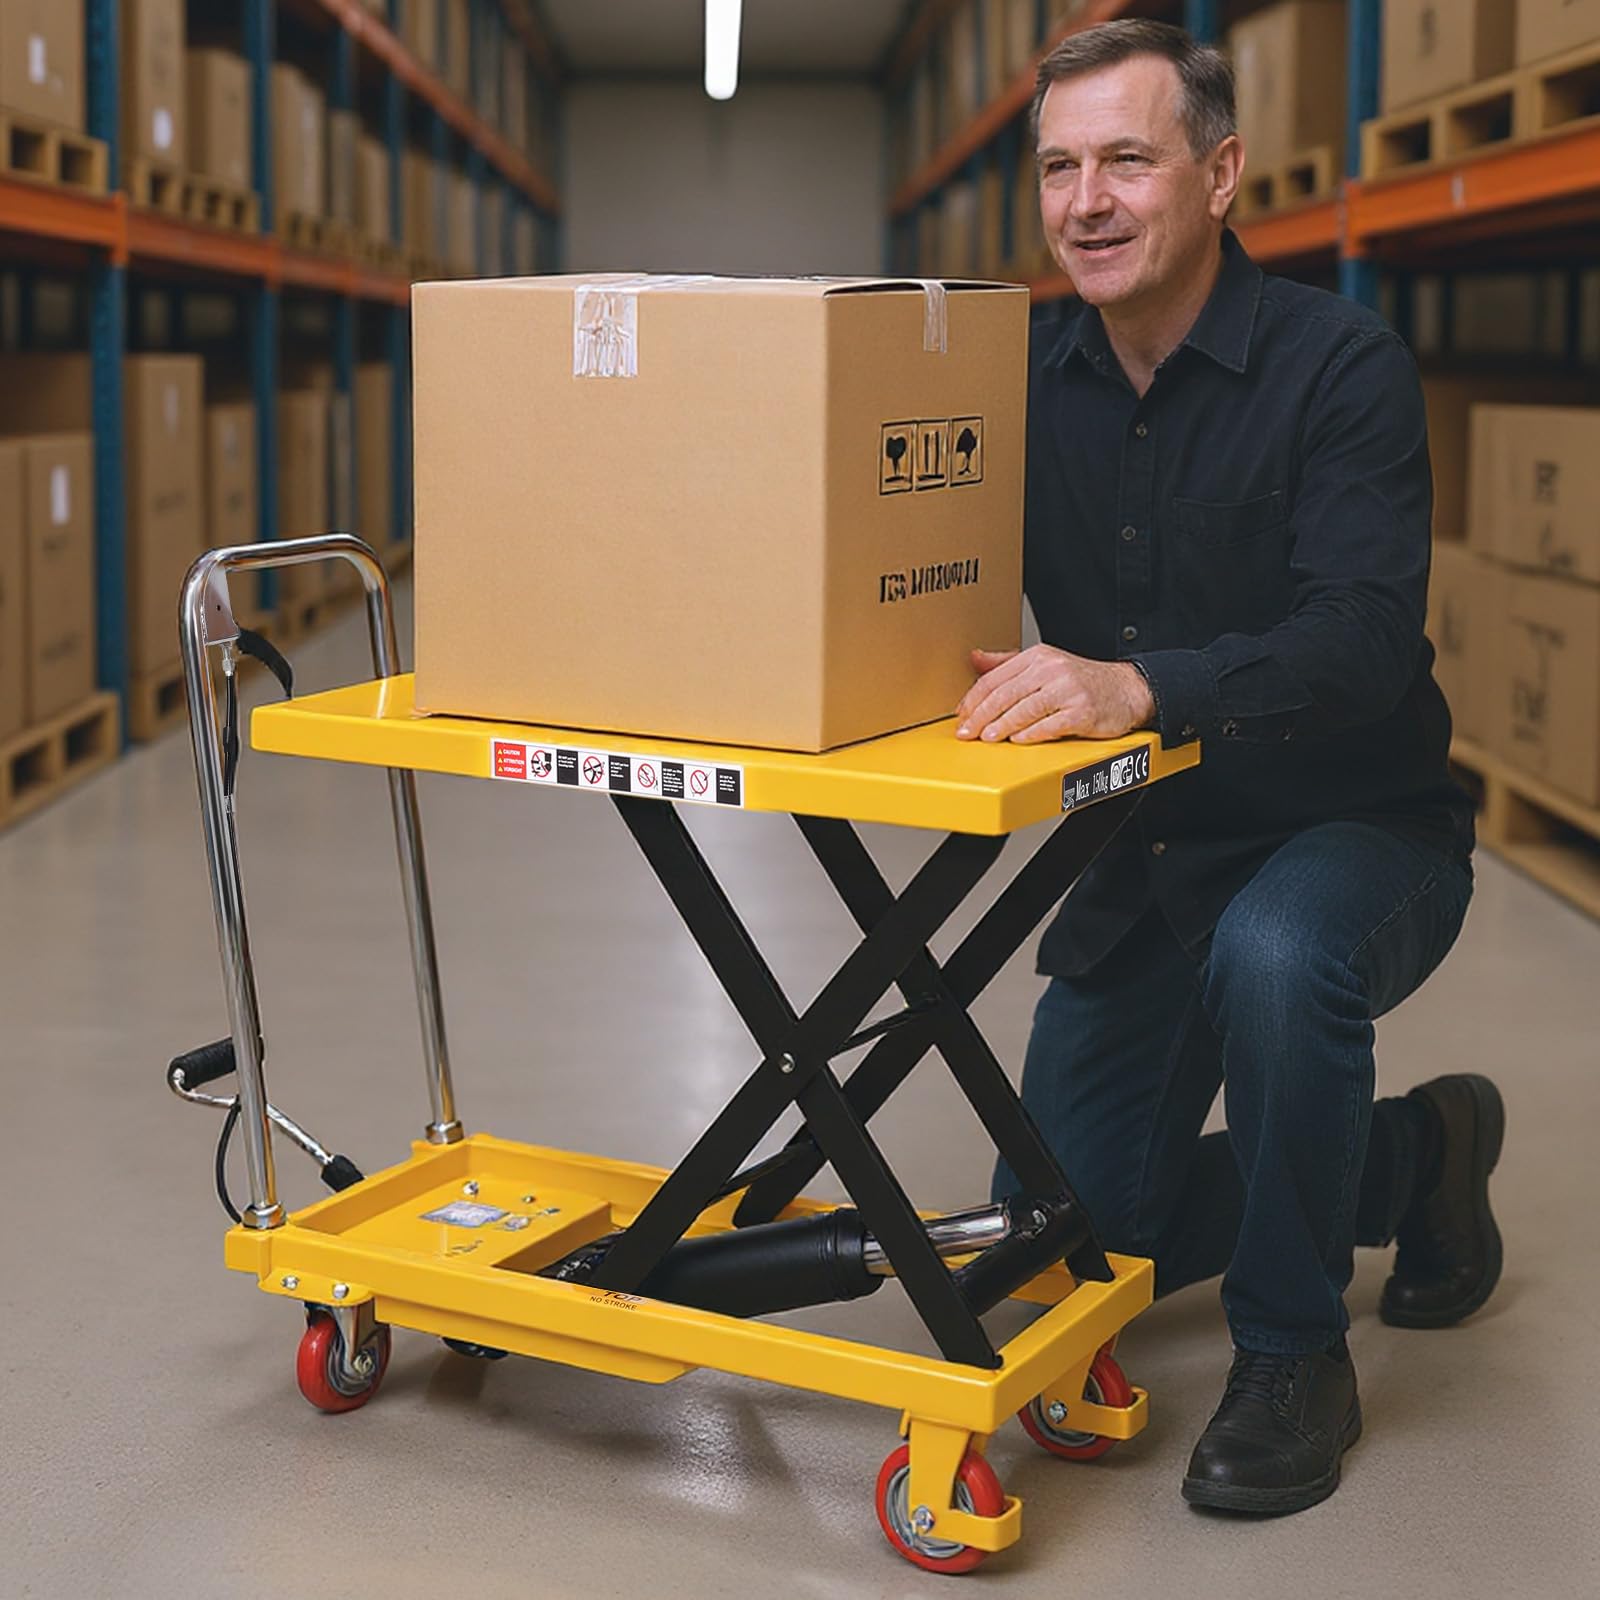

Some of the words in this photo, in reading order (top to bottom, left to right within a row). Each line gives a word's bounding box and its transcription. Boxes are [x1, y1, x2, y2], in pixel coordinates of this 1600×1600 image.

[1076, 779, 1090, 801] Max
[1092, 770, 1109, 794] 150kg
[604, 1299, 638, 1311] STROKE
